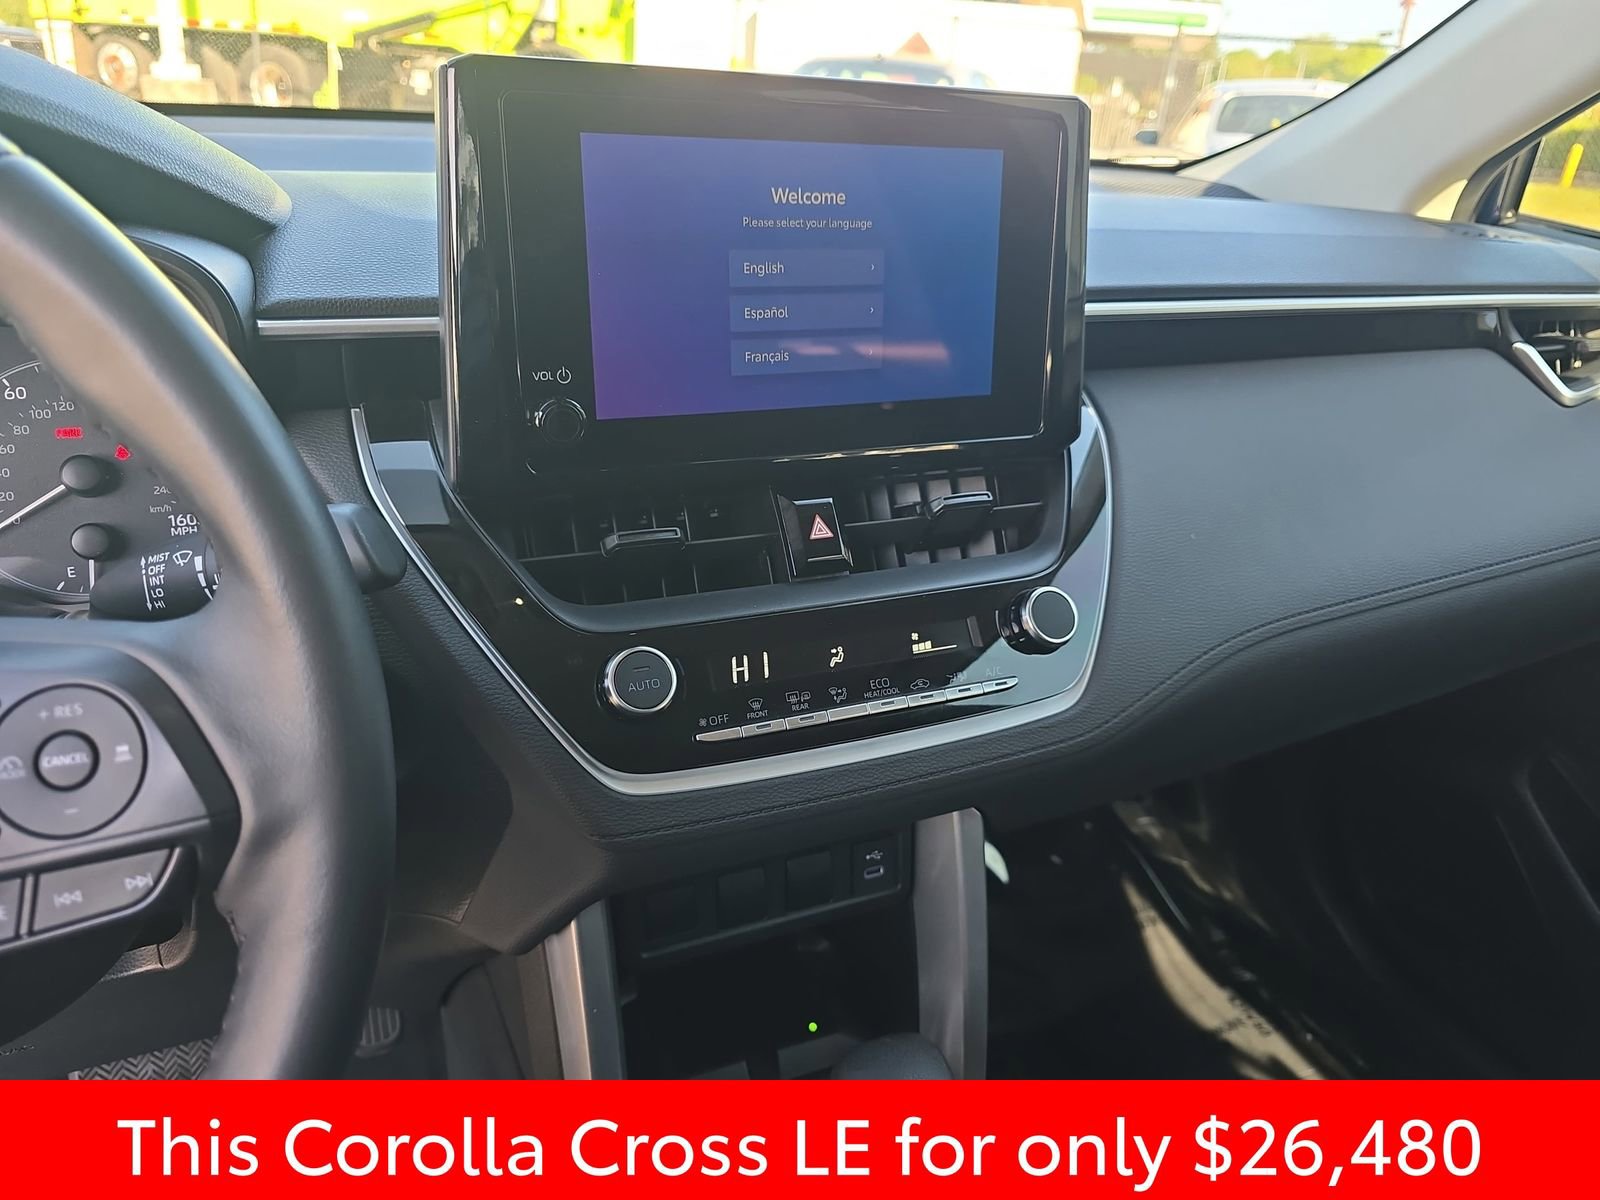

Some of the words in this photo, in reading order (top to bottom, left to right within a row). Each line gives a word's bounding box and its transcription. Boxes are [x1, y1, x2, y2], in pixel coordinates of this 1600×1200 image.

[771, 187, 847, 206] Welcome
[742, 216, 774, 228] Please
[776, 217, 804, 229] select
[805, 219, 827, 230] your
[828, 217, 873, 231] language
[743, 261, 785, 277] English
[744, 306, 789, 321] Español
[745, 350, 790, 364] Français
[531, 371, 554, 381] VOL
[4, 386, 27, 400] 60
[51, 401, 75, 411] 120
[28, 409, 51, 419] 100
[13, 425, 30, 435] 80
[149, 504, 172, 513] km/h
[167, 513, 197, 527] 160
[170, 525, 198, 537] MPH
[147, 551, 171, 564] MIST
[67, 566, 76, 578] E
[147, 563, 166, 576] OFF
[149, 574, 165, 587] INT
[150, 588, 165, 599] LO
[153, 600, 166, 609] HI
[628, 678, 661, 693] AUTO
[869, 677, 890, 690] ECO
[863, 687, 901, 699] HEAT/COOL
[791, 702, 810, 712] REAR
[708, 713, 730, 726] OFF
[746, 709, 769, 720] FRONT
[41, 752, 90, 768] CANCEL
